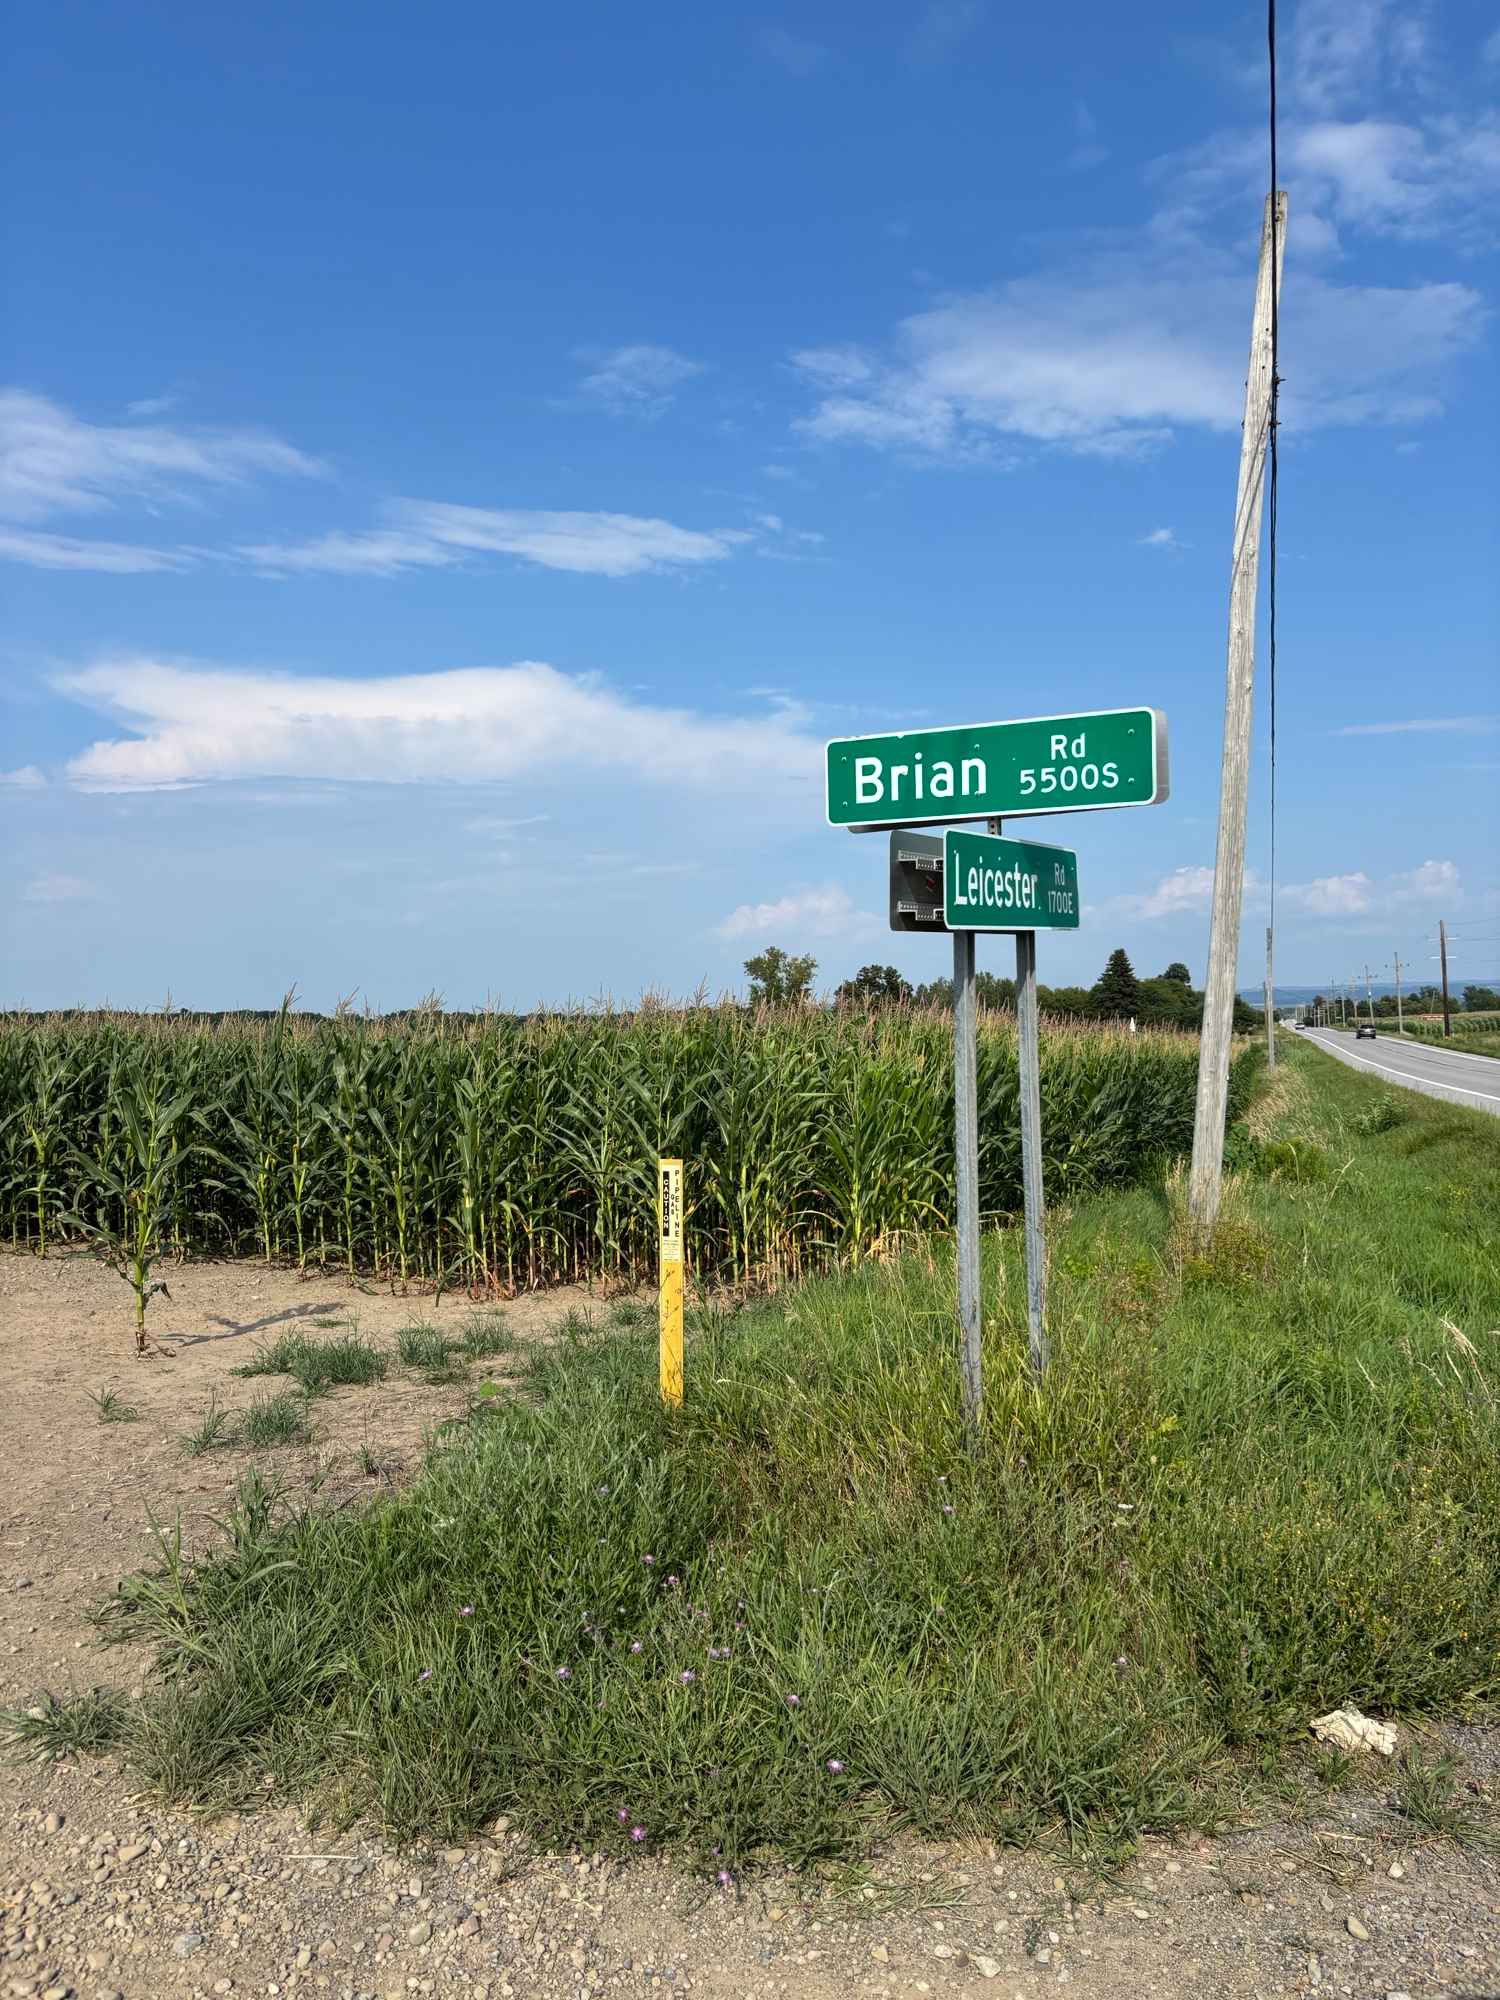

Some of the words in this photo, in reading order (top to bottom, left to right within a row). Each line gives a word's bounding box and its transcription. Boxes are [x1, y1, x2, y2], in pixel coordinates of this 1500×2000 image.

[854, 752, 987, 804] Brian
[1050, 733, 1086, 761] Rd
[1019, 762, 1119, 795] 5500S
[954, 852, 1038, 909] Leicester
[1054, 862, 1066, 886] Rd
[1047, 890, 1074, 914] 1700E
